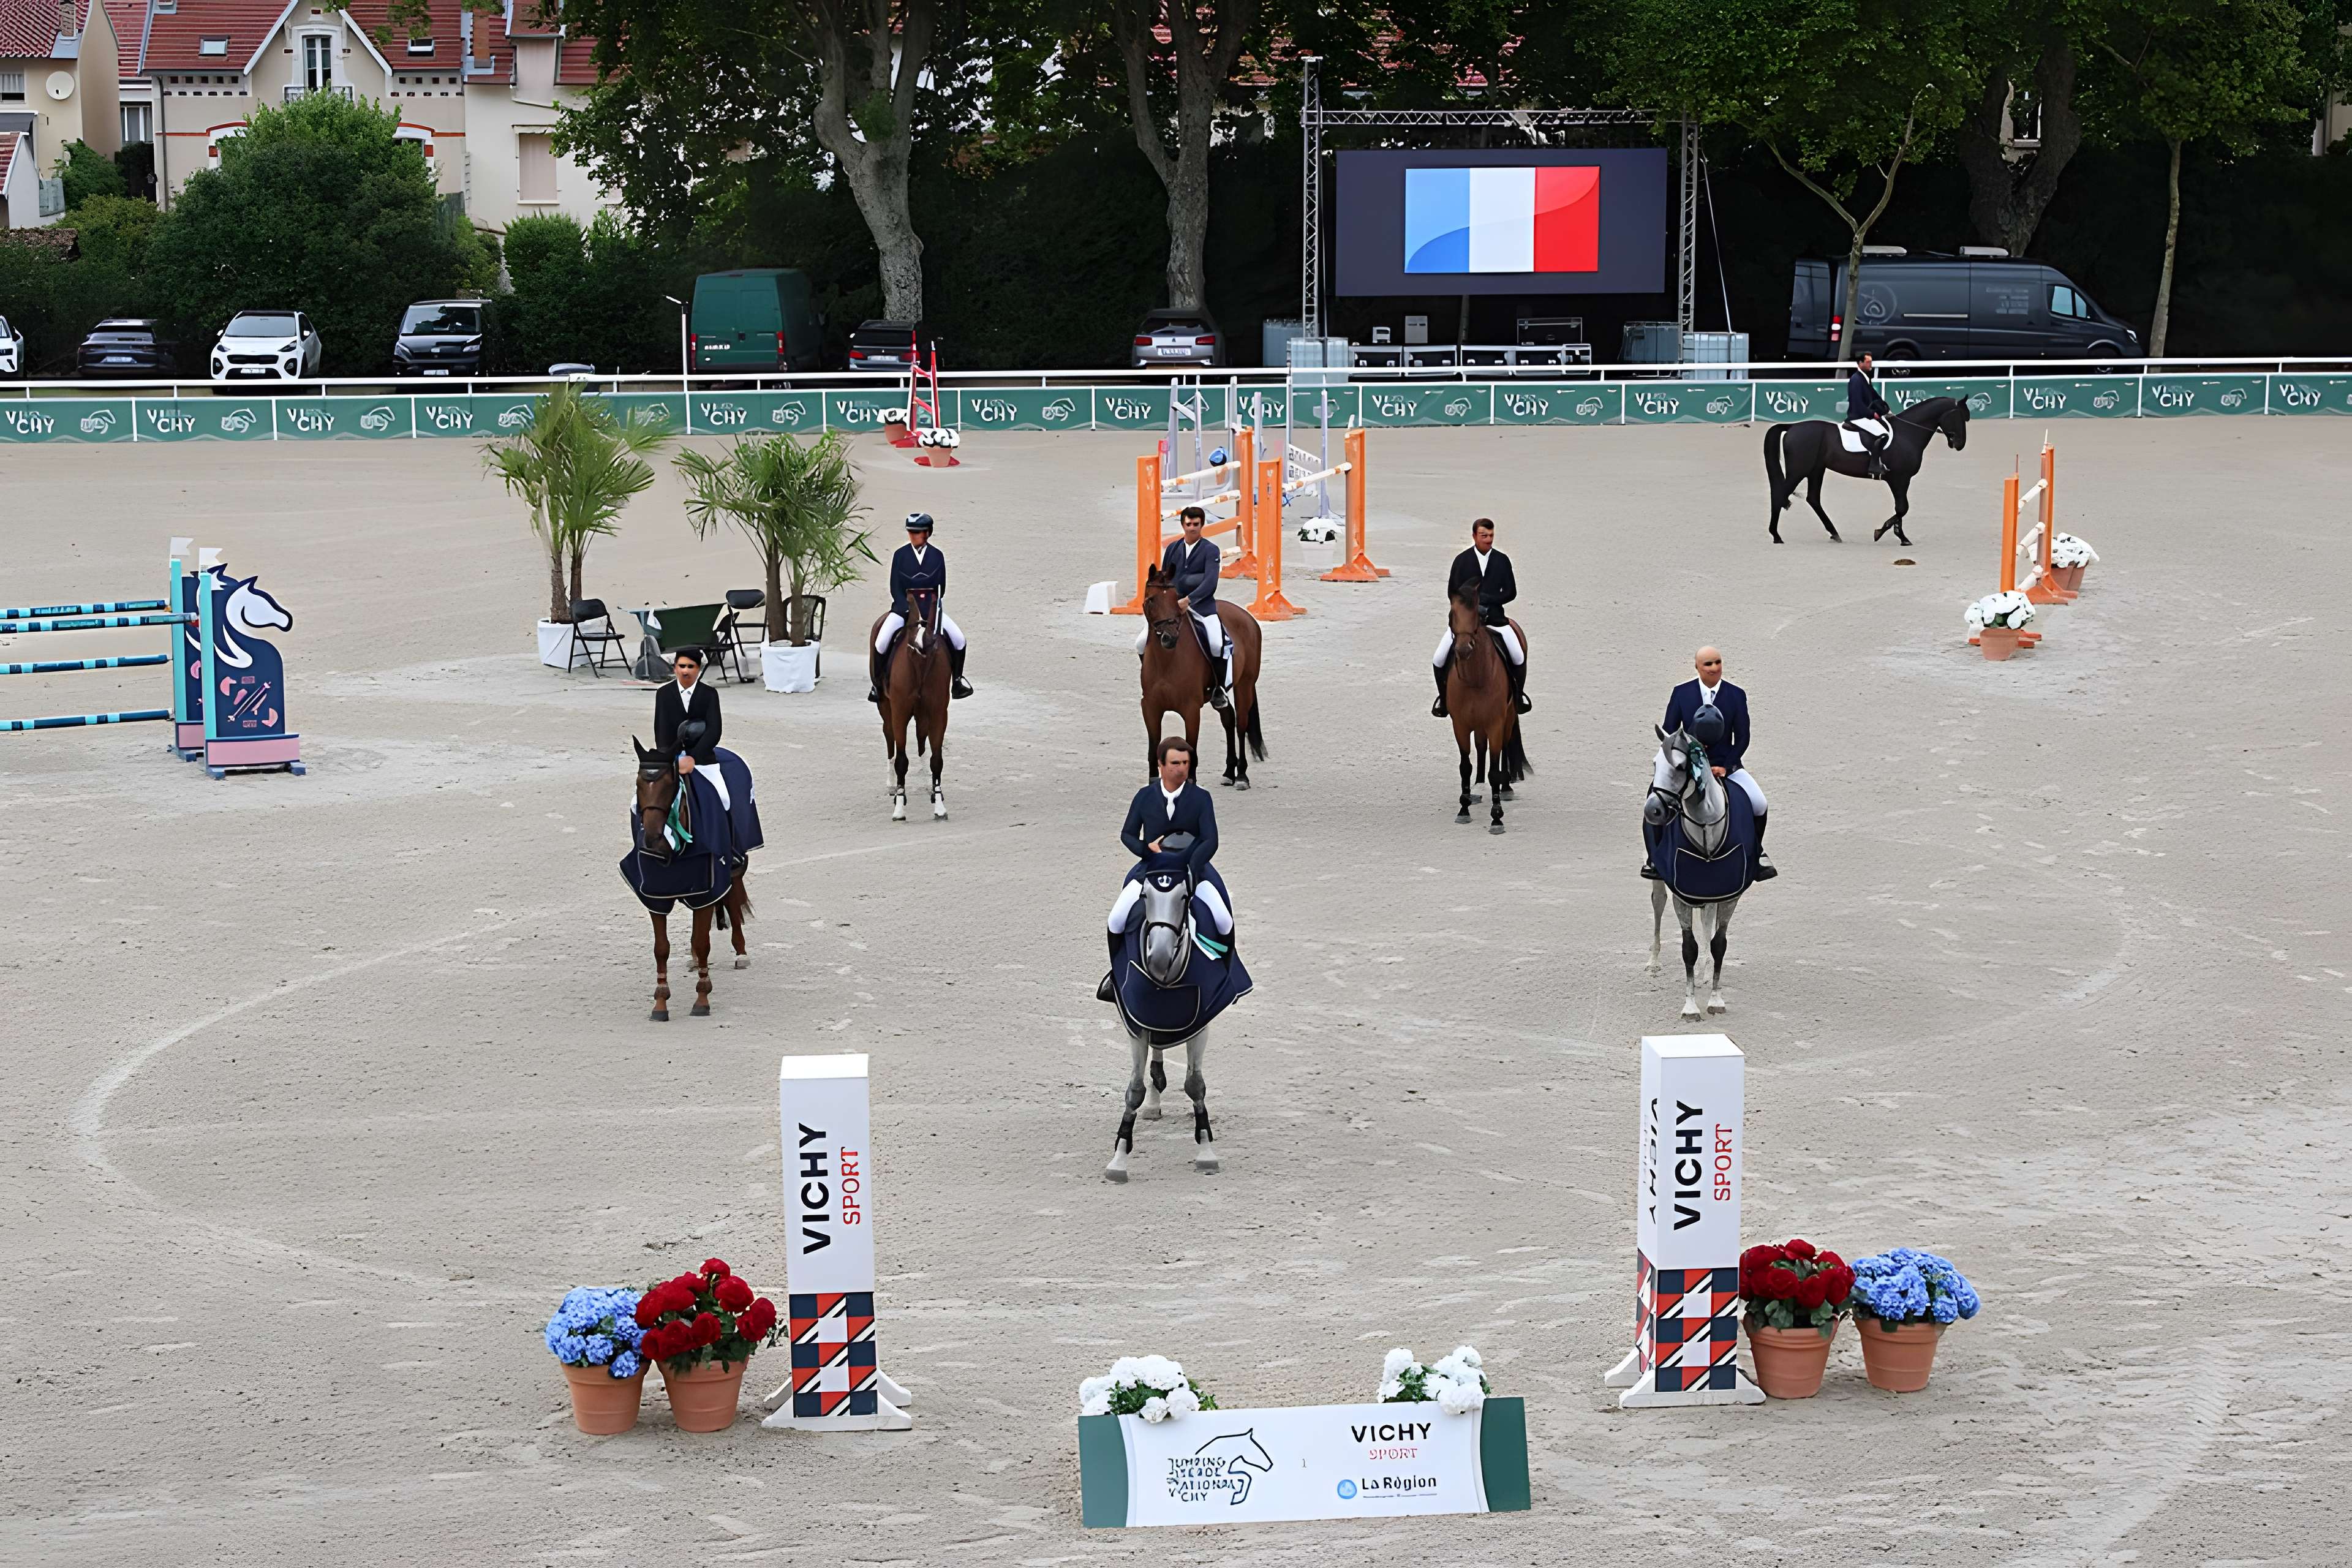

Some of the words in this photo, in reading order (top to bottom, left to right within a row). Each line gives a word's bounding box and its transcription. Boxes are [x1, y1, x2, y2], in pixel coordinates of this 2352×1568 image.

[1371, 395, 1417, 417] VICHY
[1504, 394, 1549, 415] VICHY
[1635, 393, 1679, 414] VICHY
[1765, 391, 1809, 413] VICHY
[2024, 388, 2067, 410] VICHY
[2152, 385, 2195, 407] VICHY
[287, 408, 334, 431] VICHY
[426, 406, 473, 429] VICHY
[701, 403, 747, 425] VICHY
[971, 399, 1017, 421] VICHY
[1105, 398, 1152, 420] VICHY
[146, 409, 195, 432] VICHY
[1673, 1099, 1703, 1231] VICHY
[1714, 1123, 1733, 1202] SPORT
[797, 1121, 831, 1255] VICHY
[840, 1146, 861, 1226] SPORT
[1351, 1422, 1431, 1443] VICHY
[1369, 1447, 1418, 1460] SPORT
[1362, 1477, 1380, 1490] La
